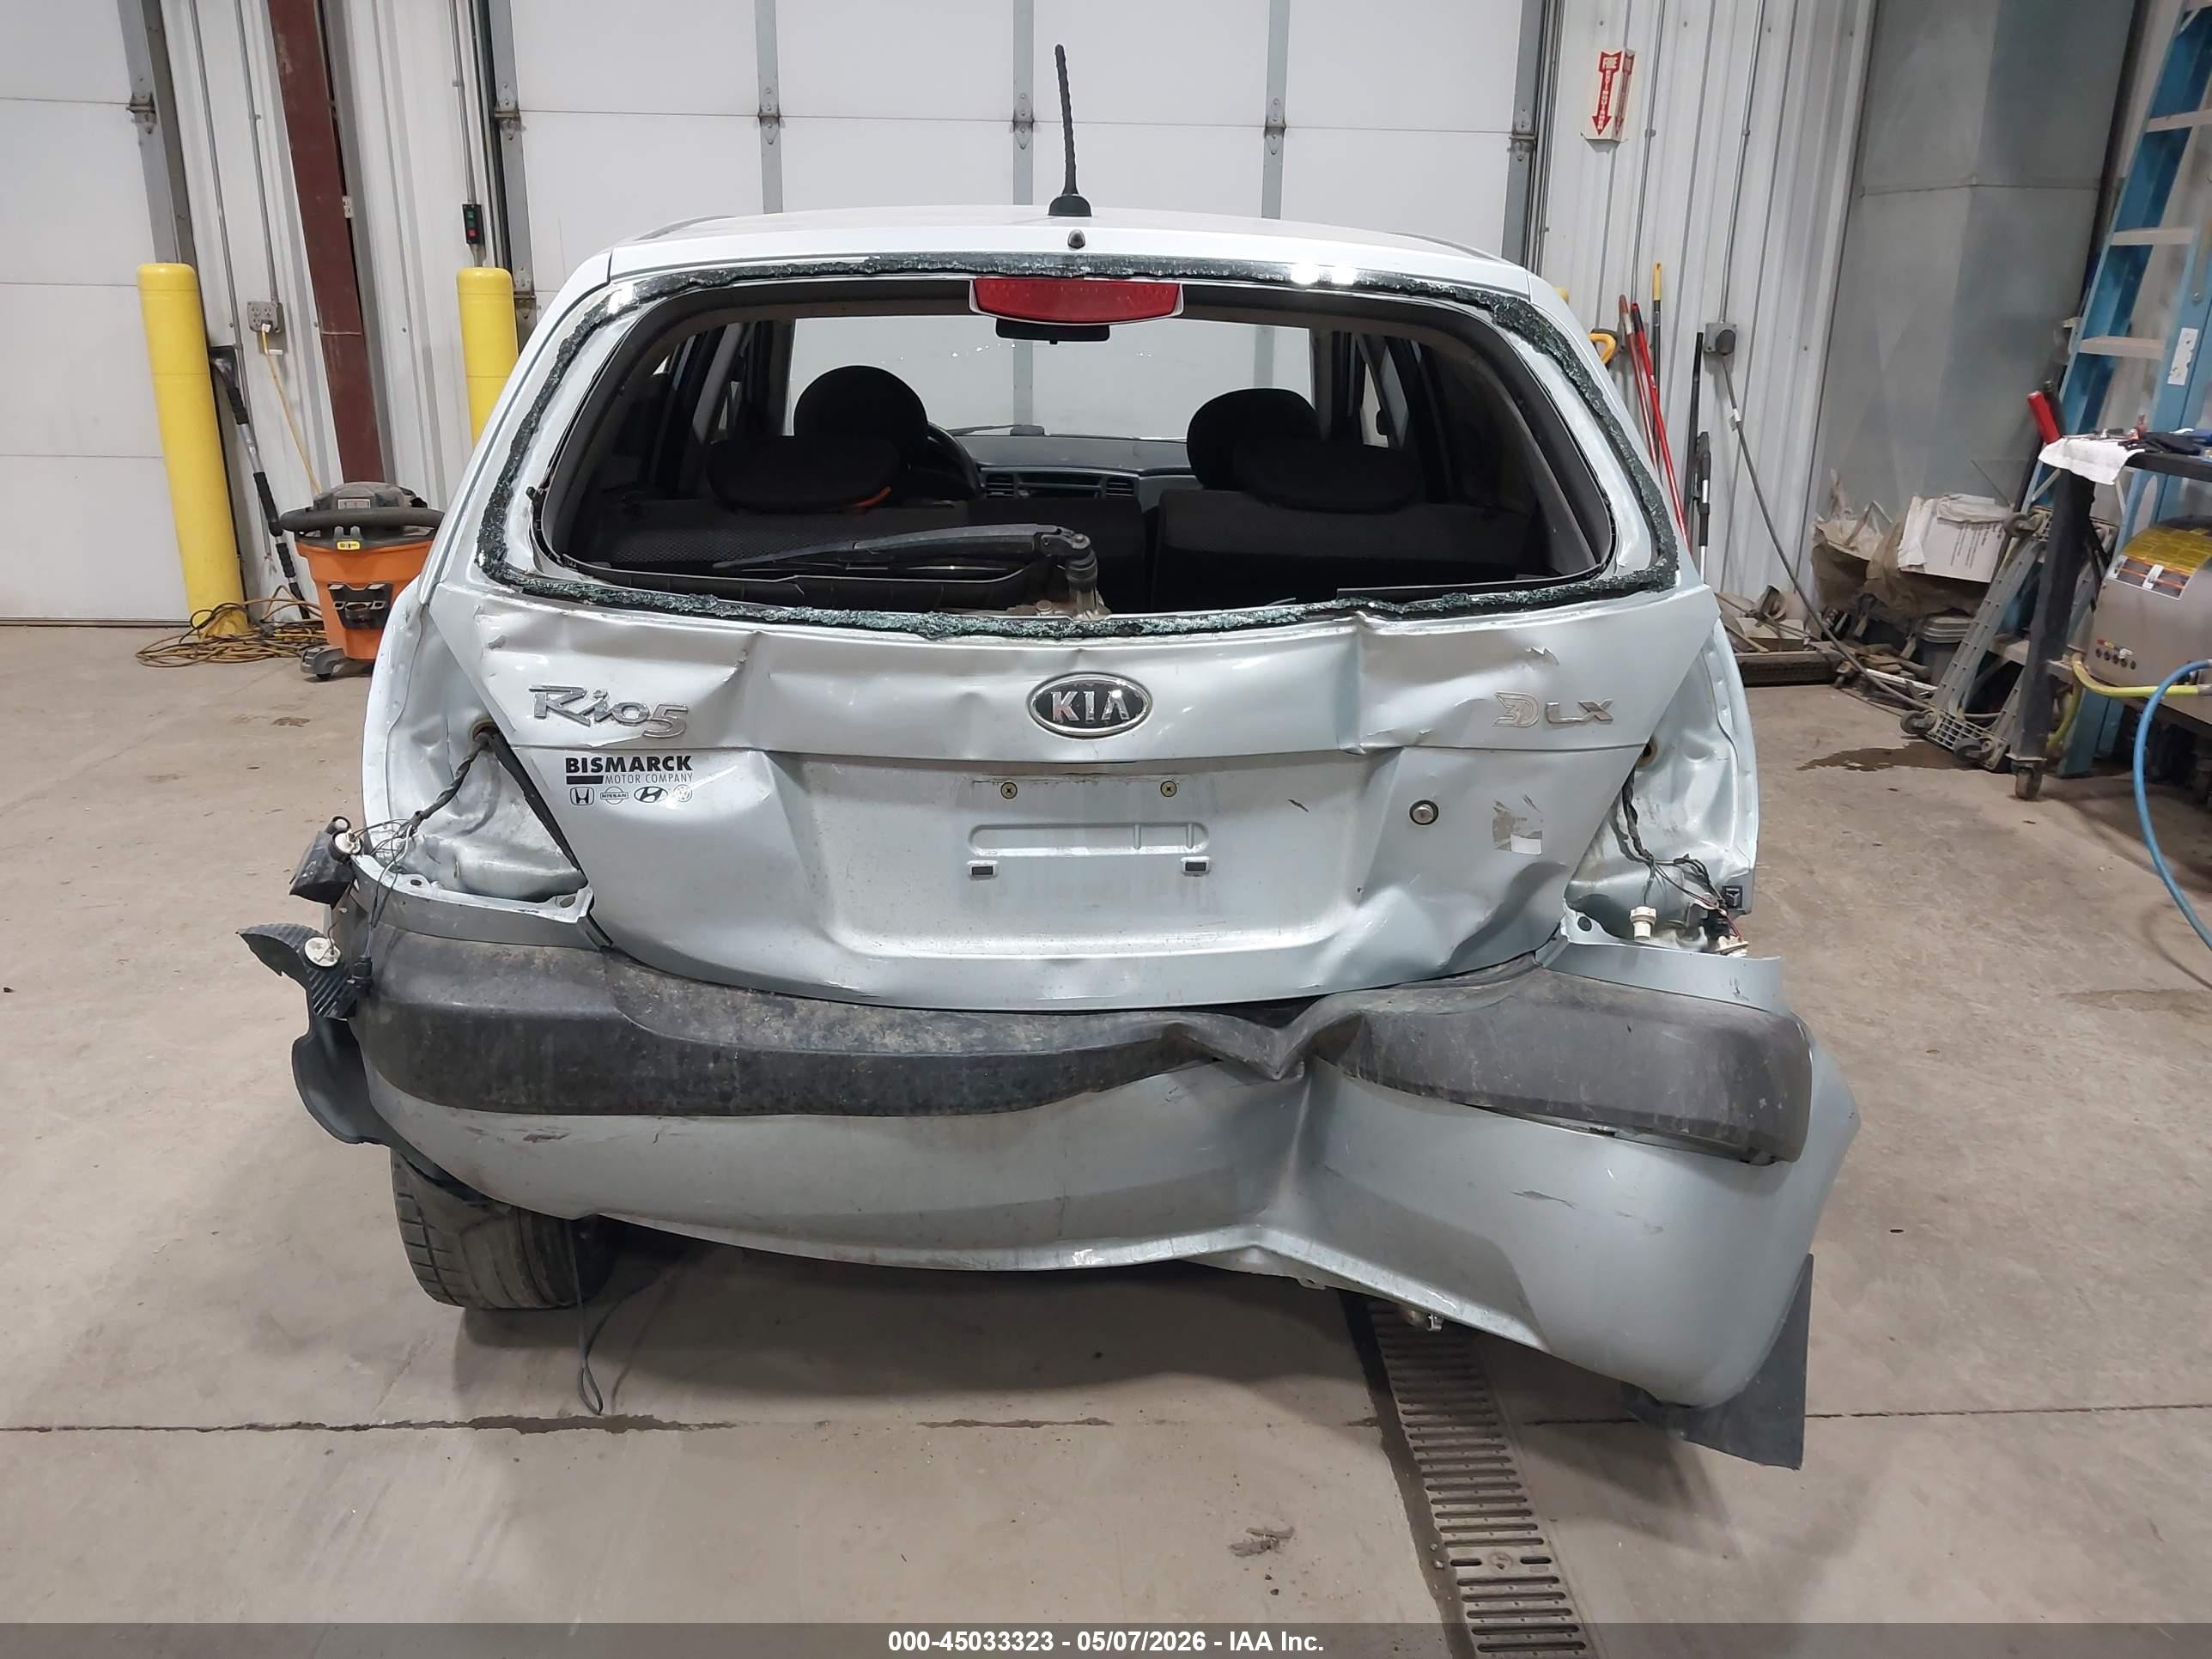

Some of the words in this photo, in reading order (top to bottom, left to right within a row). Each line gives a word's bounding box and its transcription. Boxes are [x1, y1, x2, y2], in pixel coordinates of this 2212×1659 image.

[528, 684, 689, 738] Rio5
[1050, 690, 1131, 722] KIA
[565, 755, 694, 774] BISMARCK
[605, 775, 641, 785] MOTOR
[645, 773, 693, 784] COMPANY
